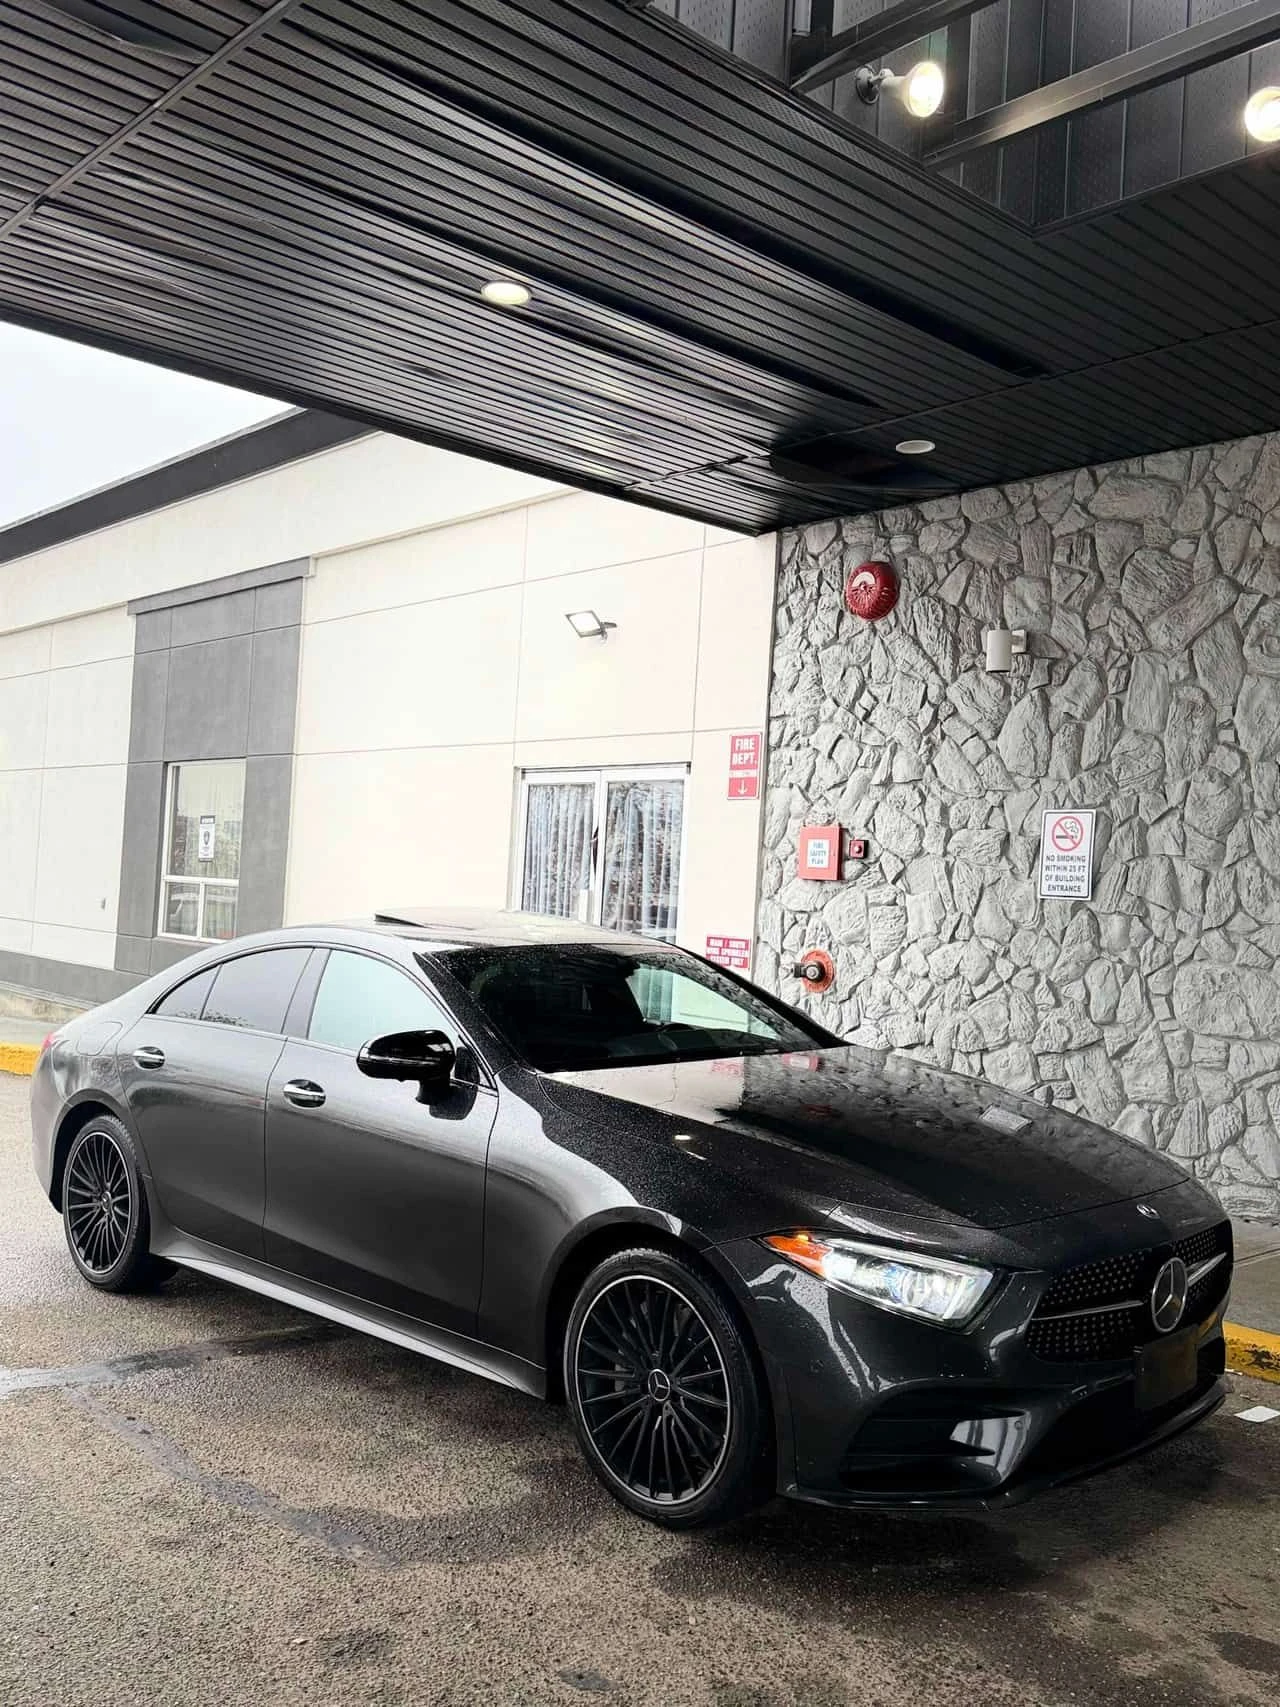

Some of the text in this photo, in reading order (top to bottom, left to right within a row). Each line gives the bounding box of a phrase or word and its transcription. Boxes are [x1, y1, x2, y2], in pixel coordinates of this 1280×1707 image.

[735, 738, 755, 751] FIRE
[1056, 855, 1086, 863] SMOKING
[1045, 864, 1067, 872] WITHIN
[1078, 864, 1086, 872] FT
[1055, 874, 1085, 882] BUILDING
[1047, 884, 1081, 892] ENTRANCE
